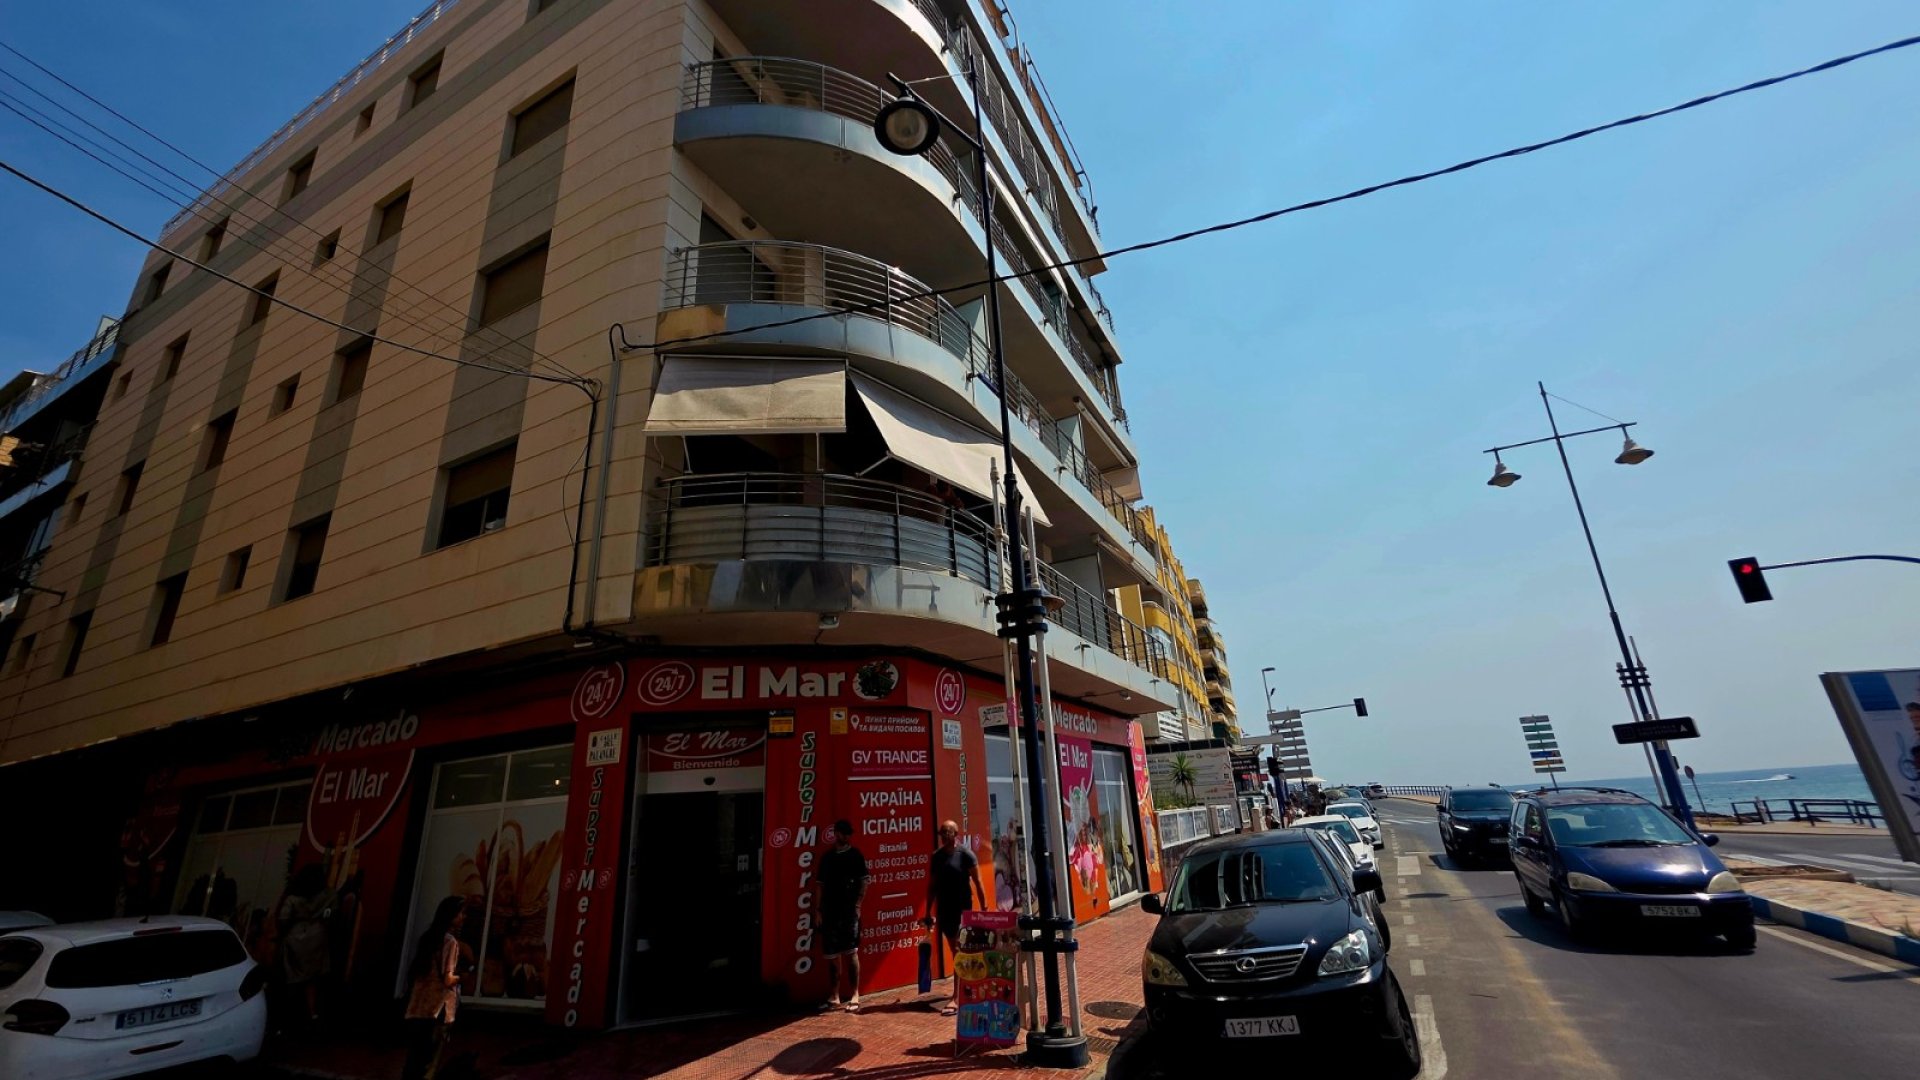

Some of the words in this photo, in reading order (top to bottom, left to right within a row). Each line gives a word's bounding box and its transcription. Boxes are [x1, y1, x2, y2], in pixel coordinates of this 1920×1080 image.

[585, 677, 615, 707] 24/7
[654, 674, 686, 693] 24/7
[701, 665, 744, 700] El
[758, 665, 845, 700] Mar
[943, 683, 960, 702] 24/7
[1052, 702, 1098, 735] Mercado
[314, 708, 419, 757] Mercado
[663, 732, 691, 753] El
[698, 730, 748, 750] Mar
[672, 757, 741, 770] Bienvenido
[852, 750, 871, 764] GV
[874, 750, 928, 764] TRANCE
[1059, 742, 1070, 767] El
[1071, 744, 1088, 769] Mar
[318, 769, 344, 804] El
[346, 766, 390, 802] Mar
[859, 787, 925, 809] УКРАЇНА
[862, 816, 923, 836] ІСПАНІЯ
[879, 842, 908, 853] Віталій
[891, 856, 906, 867] 022
[879, 873, 894, 883] 722
[877, 905, 914, 922] Григорій
[897, 937, 913, 949] 439
[1229, 1020, 1262, 1036] 1377
[1267, 1018, 1296, 1034] KKJ
